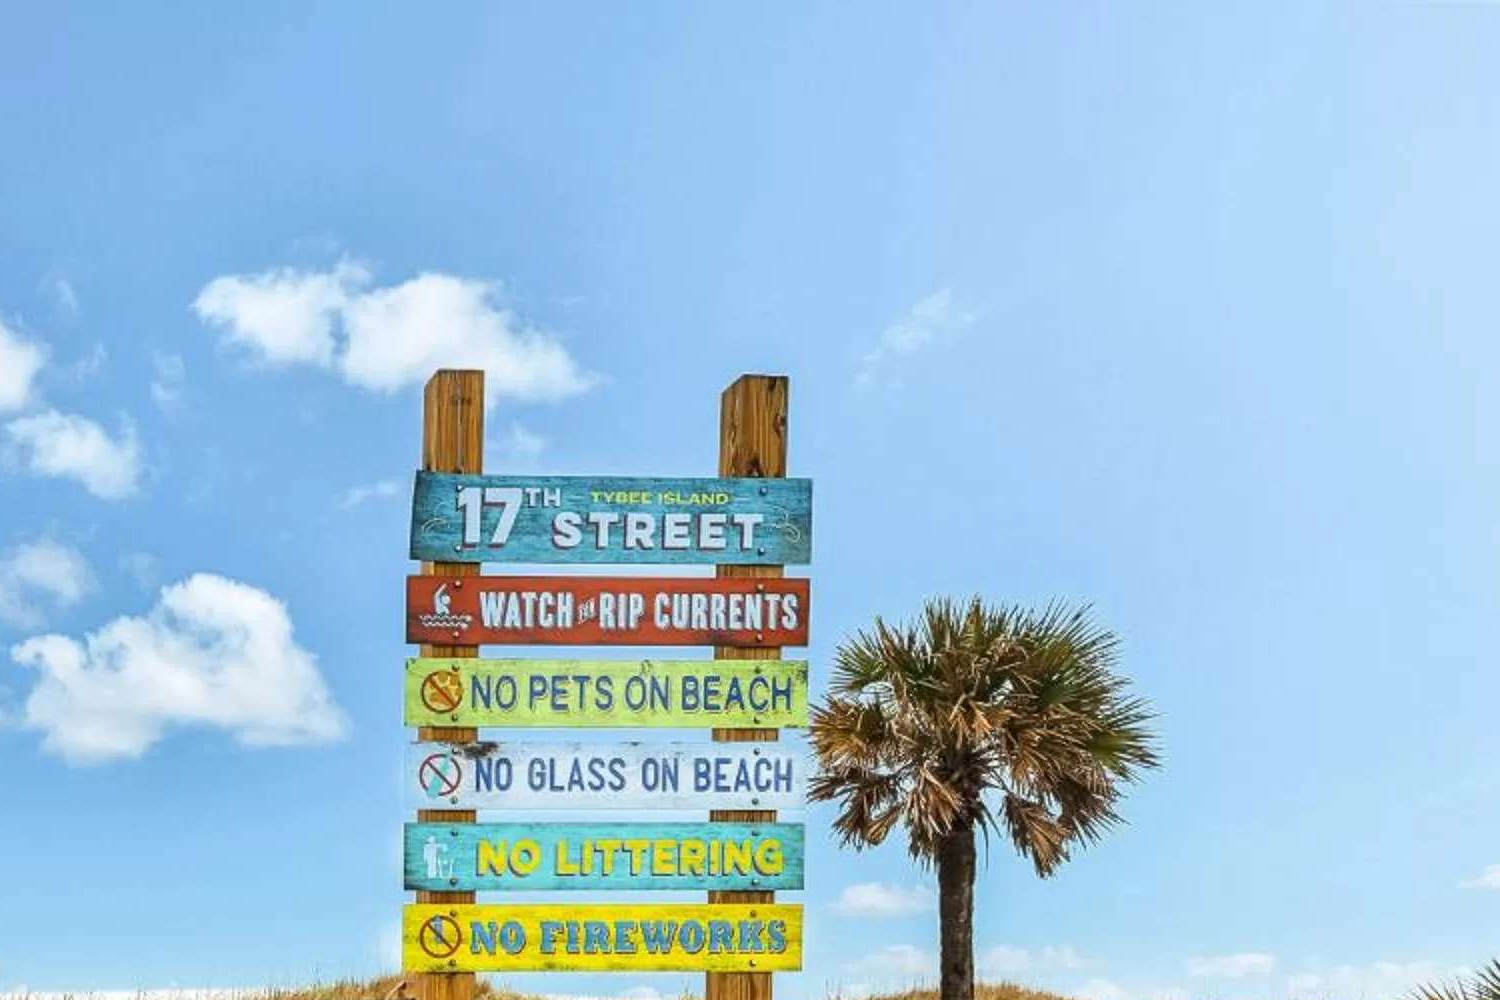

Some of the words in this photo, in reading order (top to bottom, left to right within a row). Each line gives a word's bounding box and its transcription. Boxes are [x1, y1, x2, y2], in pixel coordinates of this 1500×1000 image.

[591, 490, 653, 506] TYBEE
[658, 491, 730, 506] ISLAND
[551, 511, 765, 551] STREET
[479, 591, 574, 630] WATCH
[599, 592, 645, 631] RIP
[654, 592, 799, 632] CURRENTS
[470, 674, 518, 711] NO
[528, 675, 614, 712] PETS
[625, 675, 673, 712] ON
[681, 675, 793, 712] BEACH
[474, 757, 513, 792] NO
[528, 757, 627, 792] GLASS
[641, 757, 680, 792] ON
[694, 757, 793, 793] BEACH
[476, 838, 541, 876] NO
[555, 839, 785, 877] LITTERING
[469, 920, 526, 955] NO
[540, 919, 788, 955] FIREWORKS
